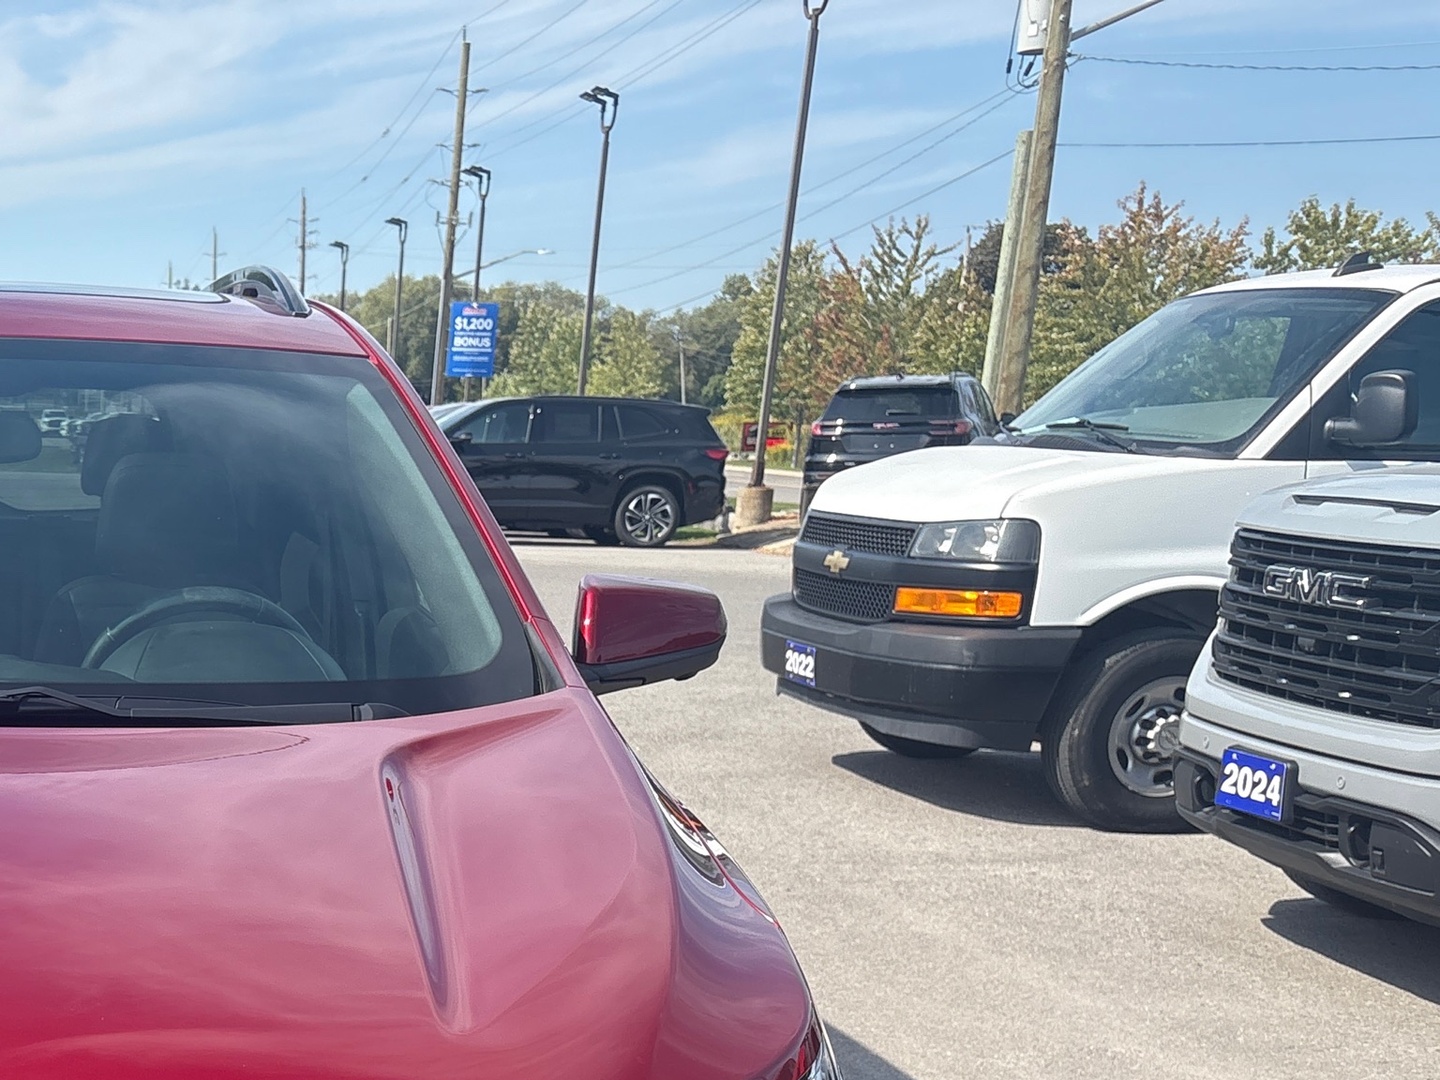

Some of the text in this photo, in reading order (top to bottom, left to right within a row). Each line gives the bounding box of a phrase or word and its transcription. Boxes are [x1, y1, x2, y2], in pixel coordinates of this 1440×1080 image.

[454, 316, 493, 330] $1,200
[453, 336, 491, 347] BONUS
[1263, 565, 1370, 610] GMC
[785, 649, 814, 678] 2022
[1220, 762, 1280, 806] 2024
